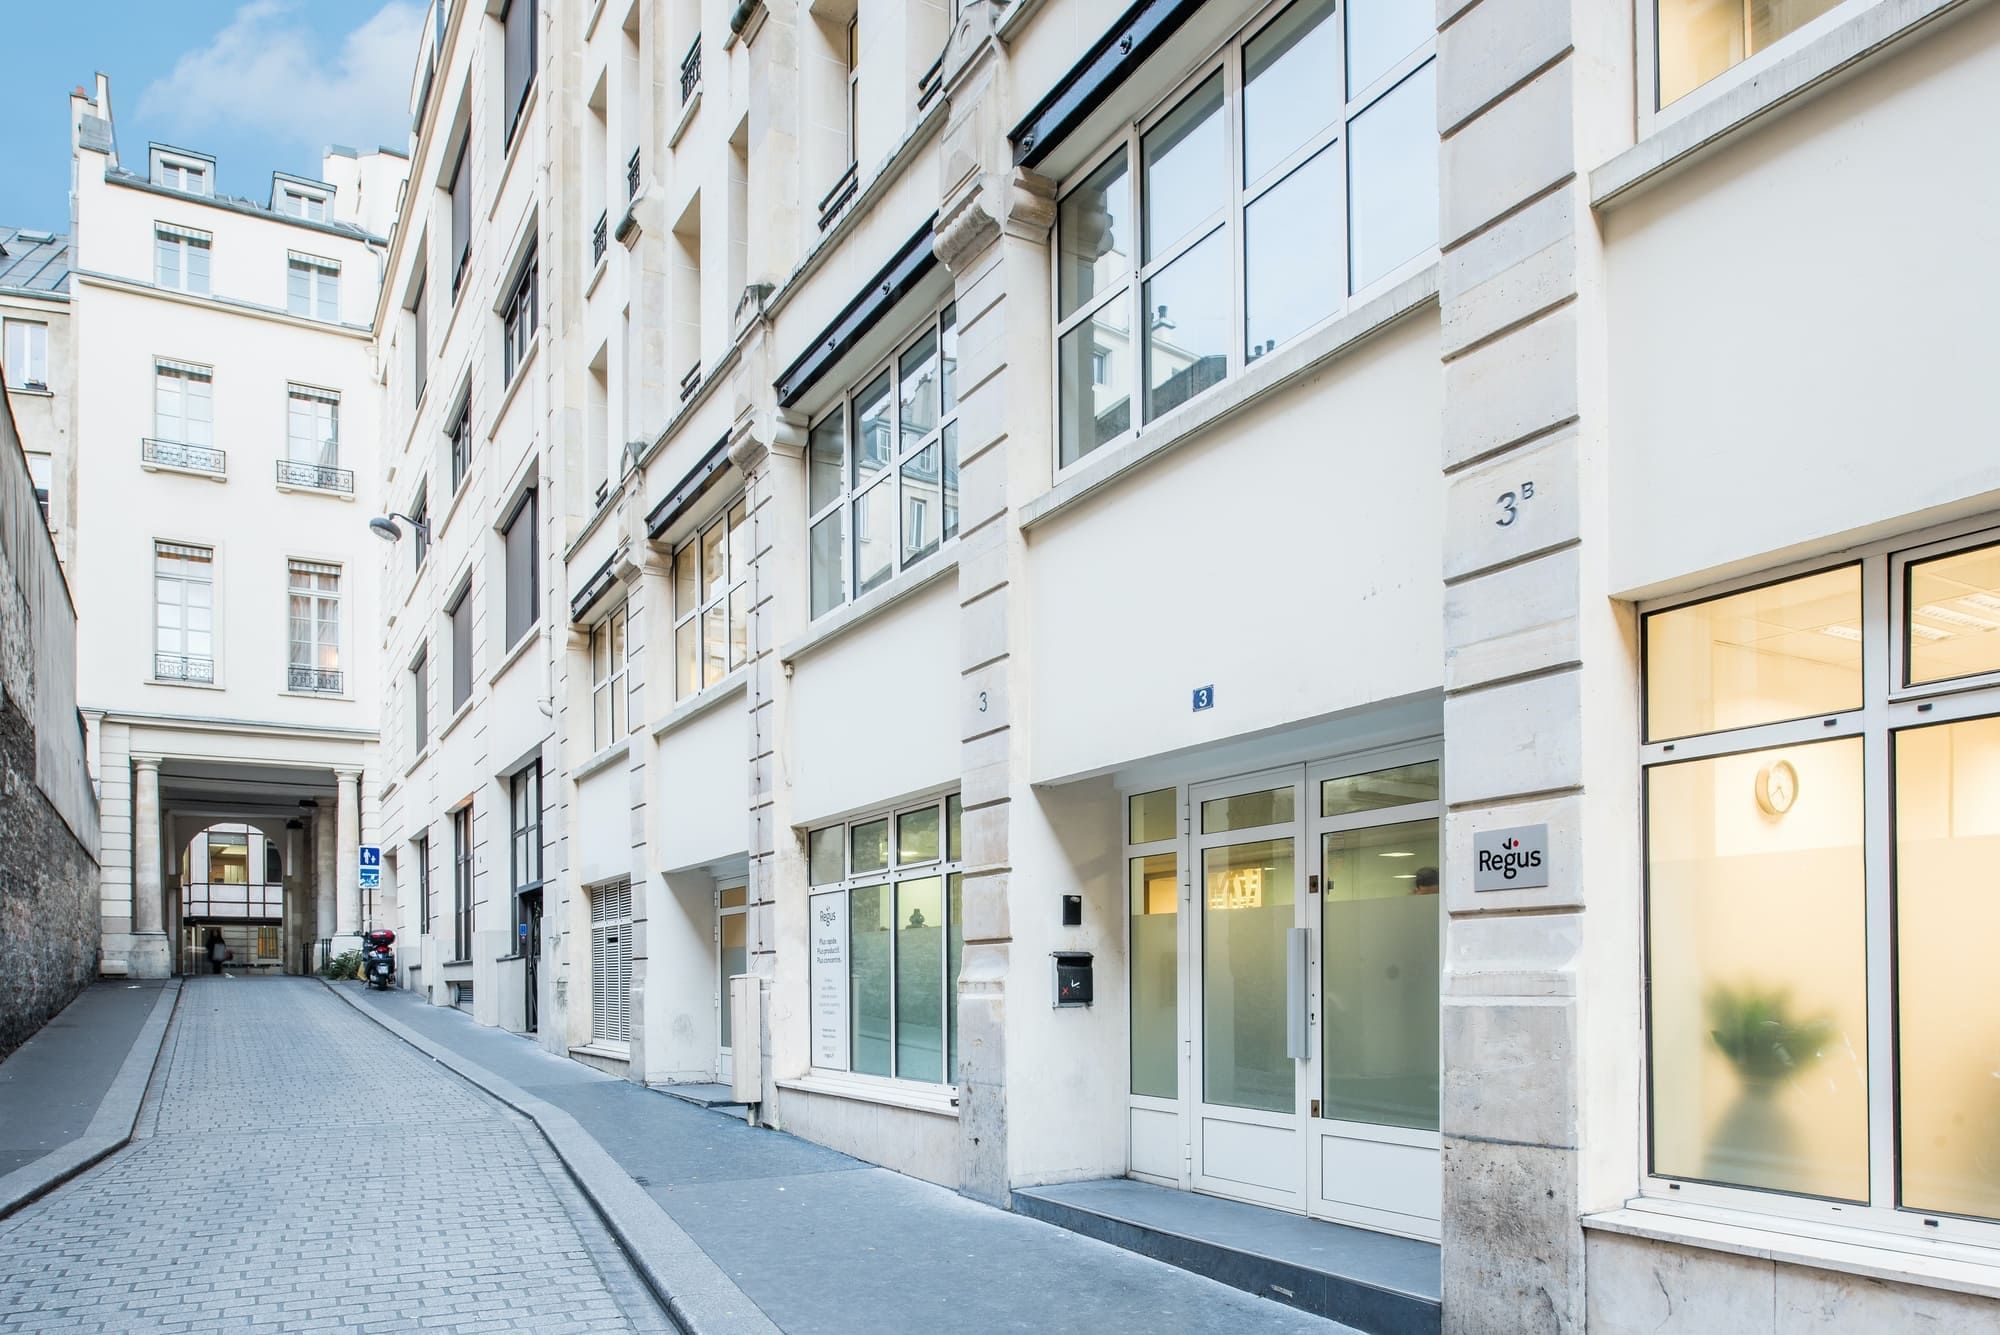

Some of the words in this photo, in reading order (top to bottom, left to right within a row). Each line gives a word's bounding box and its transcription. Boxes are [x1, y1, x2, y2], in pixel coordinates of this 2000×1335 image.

[979, 691, 987, 712] 3
[1199, 690, 1207, 706] 3
[1479, 849, 1542, 880] Regus
[820, 910, 836, 927] Regus
